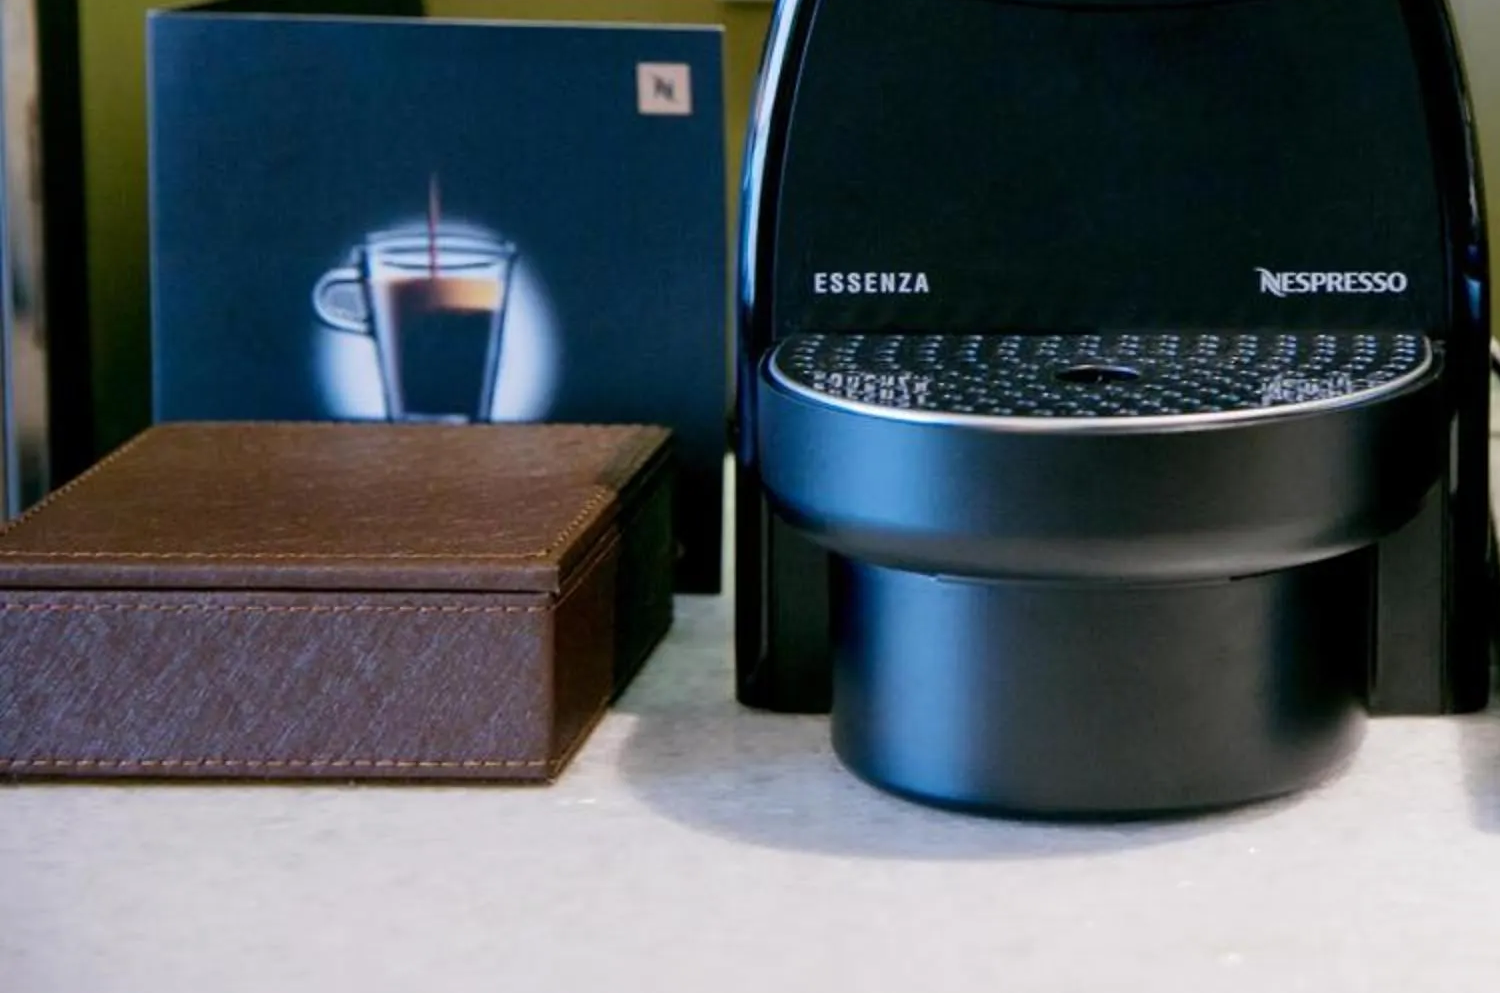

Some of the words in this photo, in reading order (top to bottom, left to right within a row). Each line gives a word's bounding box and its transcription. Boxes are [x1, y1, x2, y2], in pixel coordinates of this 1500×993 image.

[652, 75, 677, 103] N
[814, 272, 930, 293] ESSENZA
[1254, 267, 1408, 297] NESPRESSO
